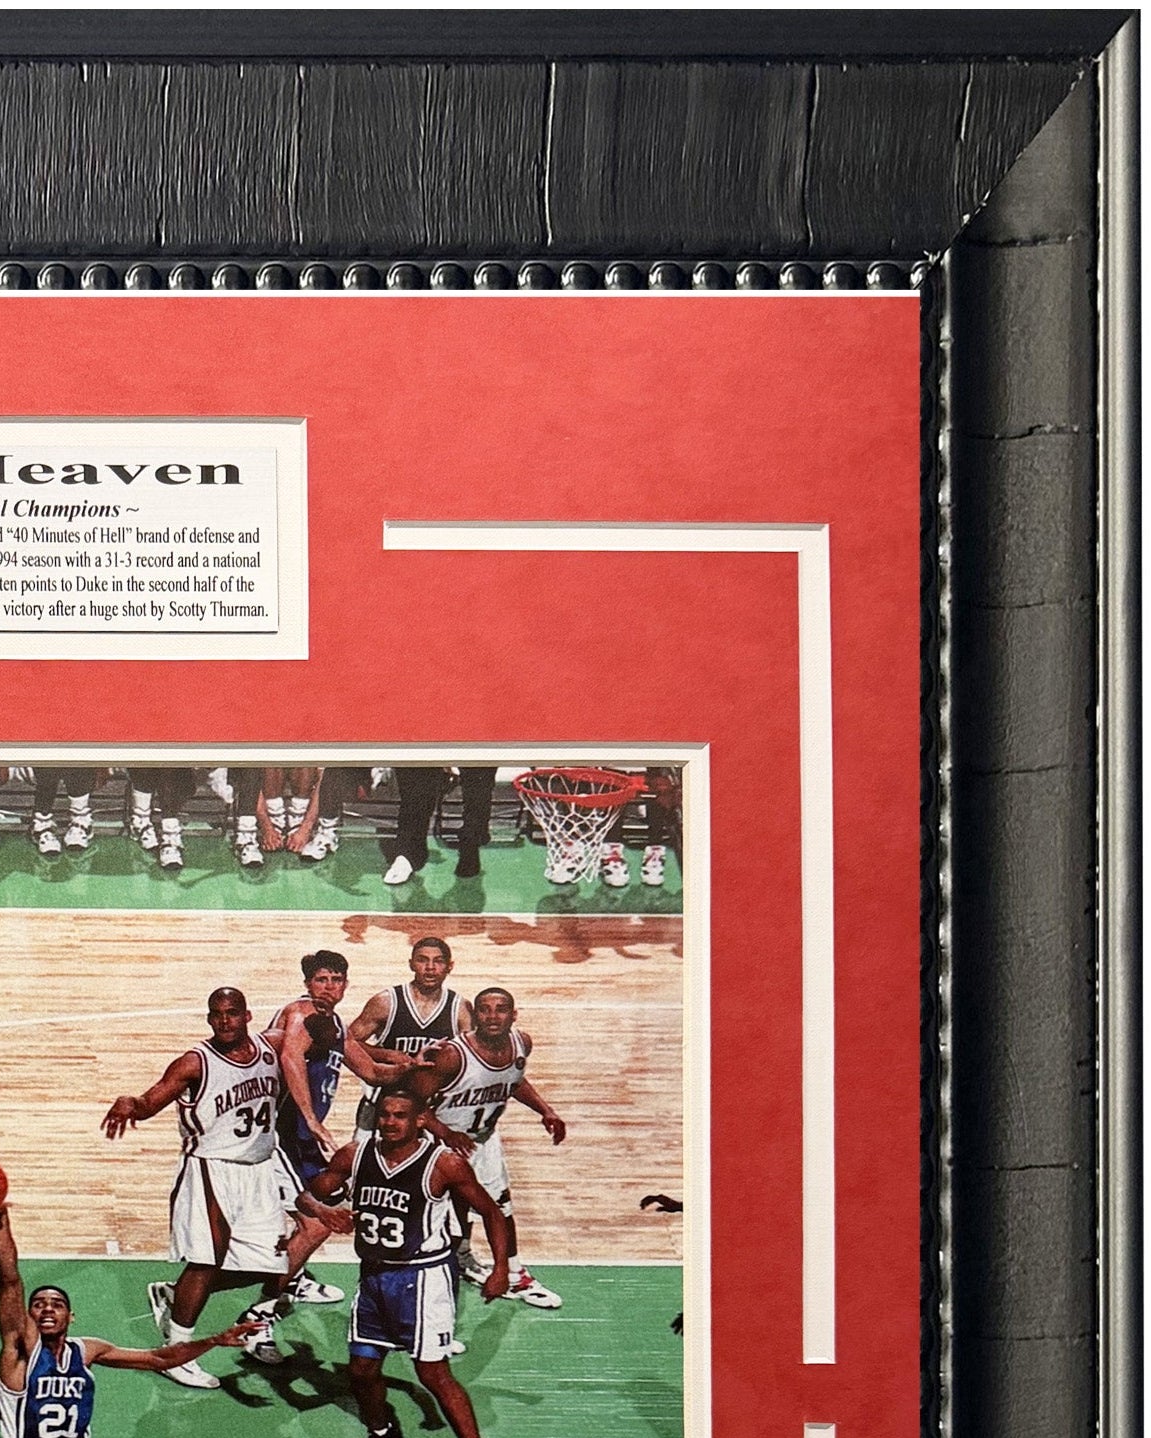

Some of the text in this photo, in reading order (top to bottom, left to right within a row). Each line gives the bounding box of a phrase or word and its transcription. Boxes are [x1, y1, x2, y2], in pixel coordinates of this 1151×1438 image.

[14, 499, 120, 523] Champions
[7, 526, 28, 543] “40
[33, 526, 80, 544] Minutes
[84, 526, 98, 544] of
[101, 526, 132, 544] Hell”
[136, 526, 169, 544] brand
[174, 526, 187, 544] of
[190, 527, 234, 544] defense
[239, 527, 259, 544] and
[22, 555, 61, 568] season
[65, 550, 90, 568] with
[95, 555, 101, 568] a
[106, 551, 131, 568] 31-3
[137, 551, 173, 568] record
[178, 551, 198, 568] and
[203, 555, 209, 568] a
[213, 551, 260, 568] national
[0, 577, 17, 592] ten
[21, 574, 57, 597] points
[61, 577, 72, 592] to
[76, 575, 108, 592] Duke
[112, 575, 123, 592] in
[127, 575, 145, 592] the
[149, 575, 189, 593] second
[193, 576, 218, 592] half
[220, 576, 235, 592] of
[236, 577, 255, 592] the
[4, 599, 44, 621] victory
[49, 599, 76, 617] after
[80, 604, 86, 617] a
[90, 600, 118, 622] huge
[123, 600, 146, 617] shot
[151, 600, 165, 622] by
[170, 600, 206, 622] Scotty
[210, 600, 268, 617] Thurman.
[396, 1036, 446, 1054] DUK
[233, 1101, 271, 1138] 34
[359, 1186, 411, 1214] DUKE
[360, 1212, 405, 1249] 33
[35, 1376, 87, 1399] DUKE
